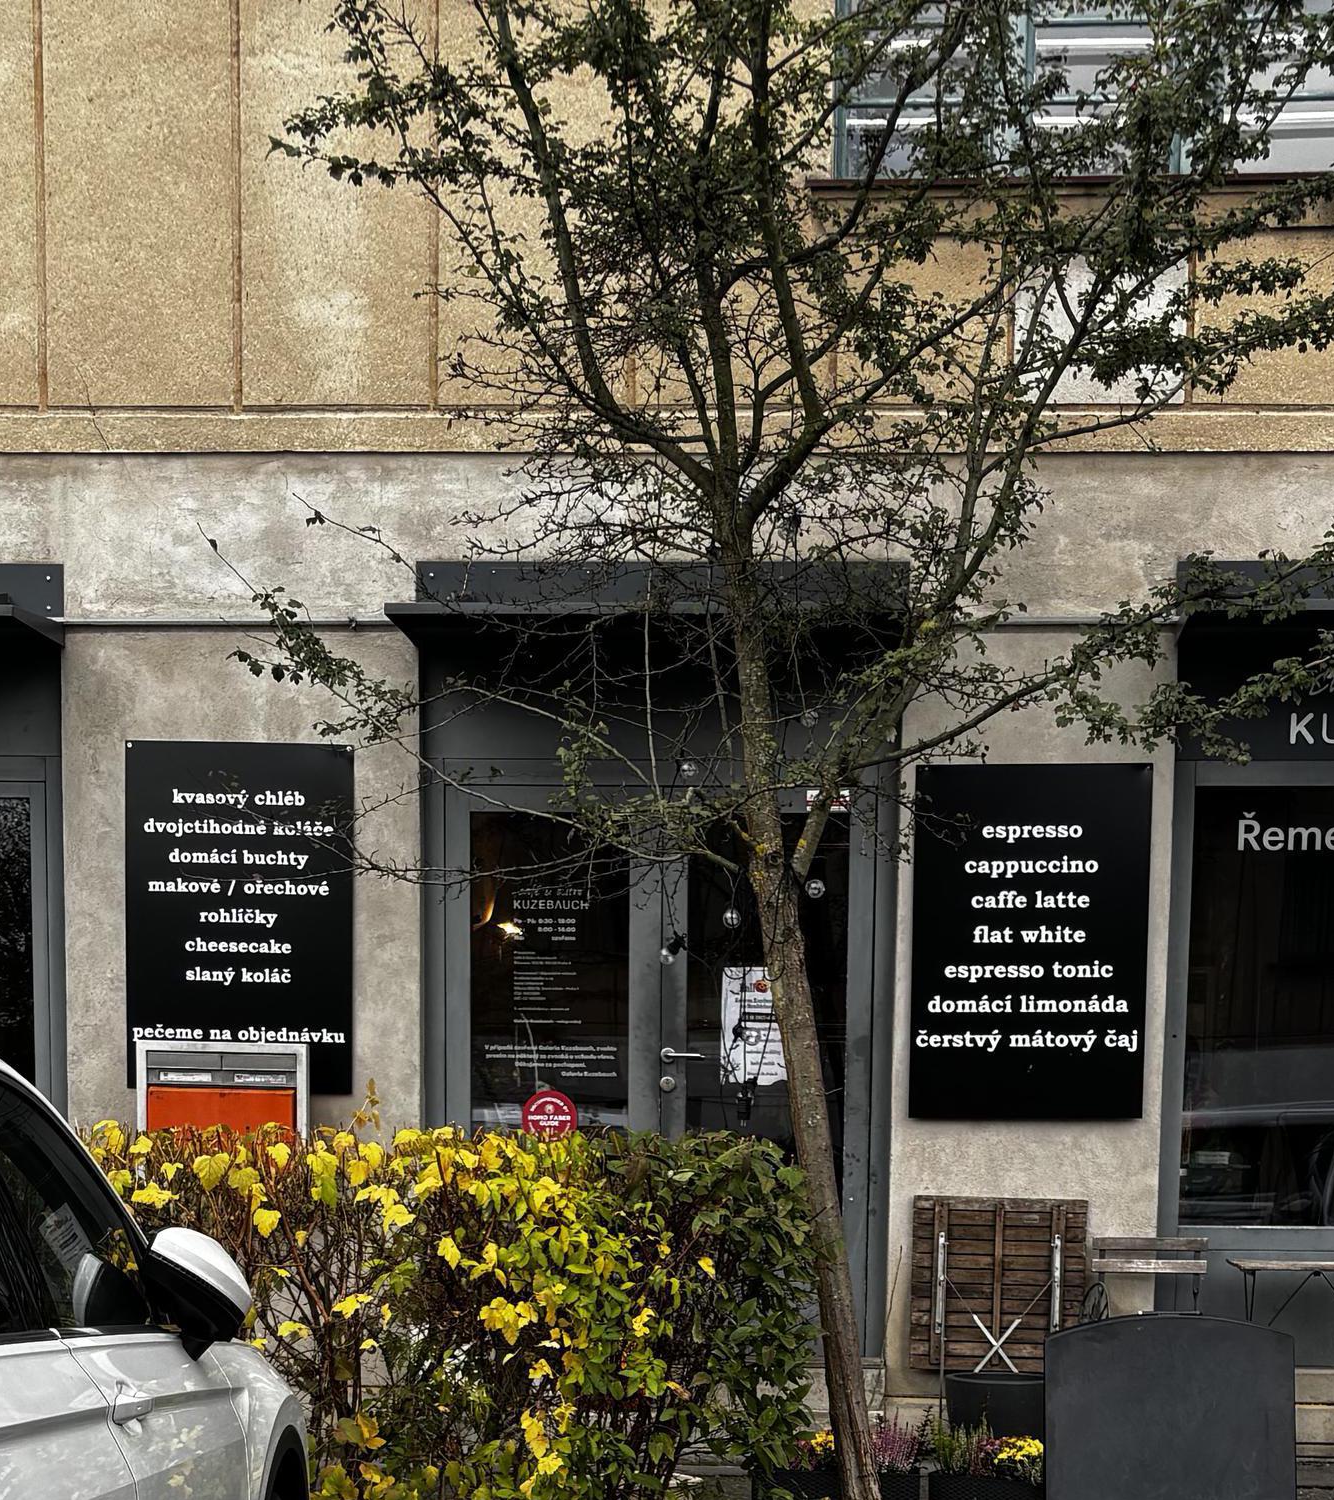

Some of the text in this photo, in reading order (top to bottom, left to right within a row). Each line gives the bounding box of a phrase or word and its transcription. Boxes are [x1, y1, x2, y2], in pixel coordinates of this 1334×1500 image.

[173, 789, 304, 808] kvasový chléb
[144, 818, 266, 837] dvojctihodné
[982, 825, 1082, 843] espresso
[169, 848, 308, 869] domácí buchty
[965, 856, 1098, 878] cappuccino
[149, 878, 329, 896] makové / ořechové
[513, 900, 588, 909] KUZEBAUCH
[971, 891, 1089, 908] caffe latte
[200, 909, 277, 927] rohlíčky
[973, 926, 1085, 943] flat white
[185, 938, 291, 953] cheesecake
[186, 967, 291, 985] slaný koláč
[945, 960, 1113, 982] espresso tonic
[928, 995, 1128, 1012] domácí limonáda
[133, 1024, 346, 1044] pečeme na objednávku
[916, 1030, 1137, 1052] čerstvý mátový čaj
